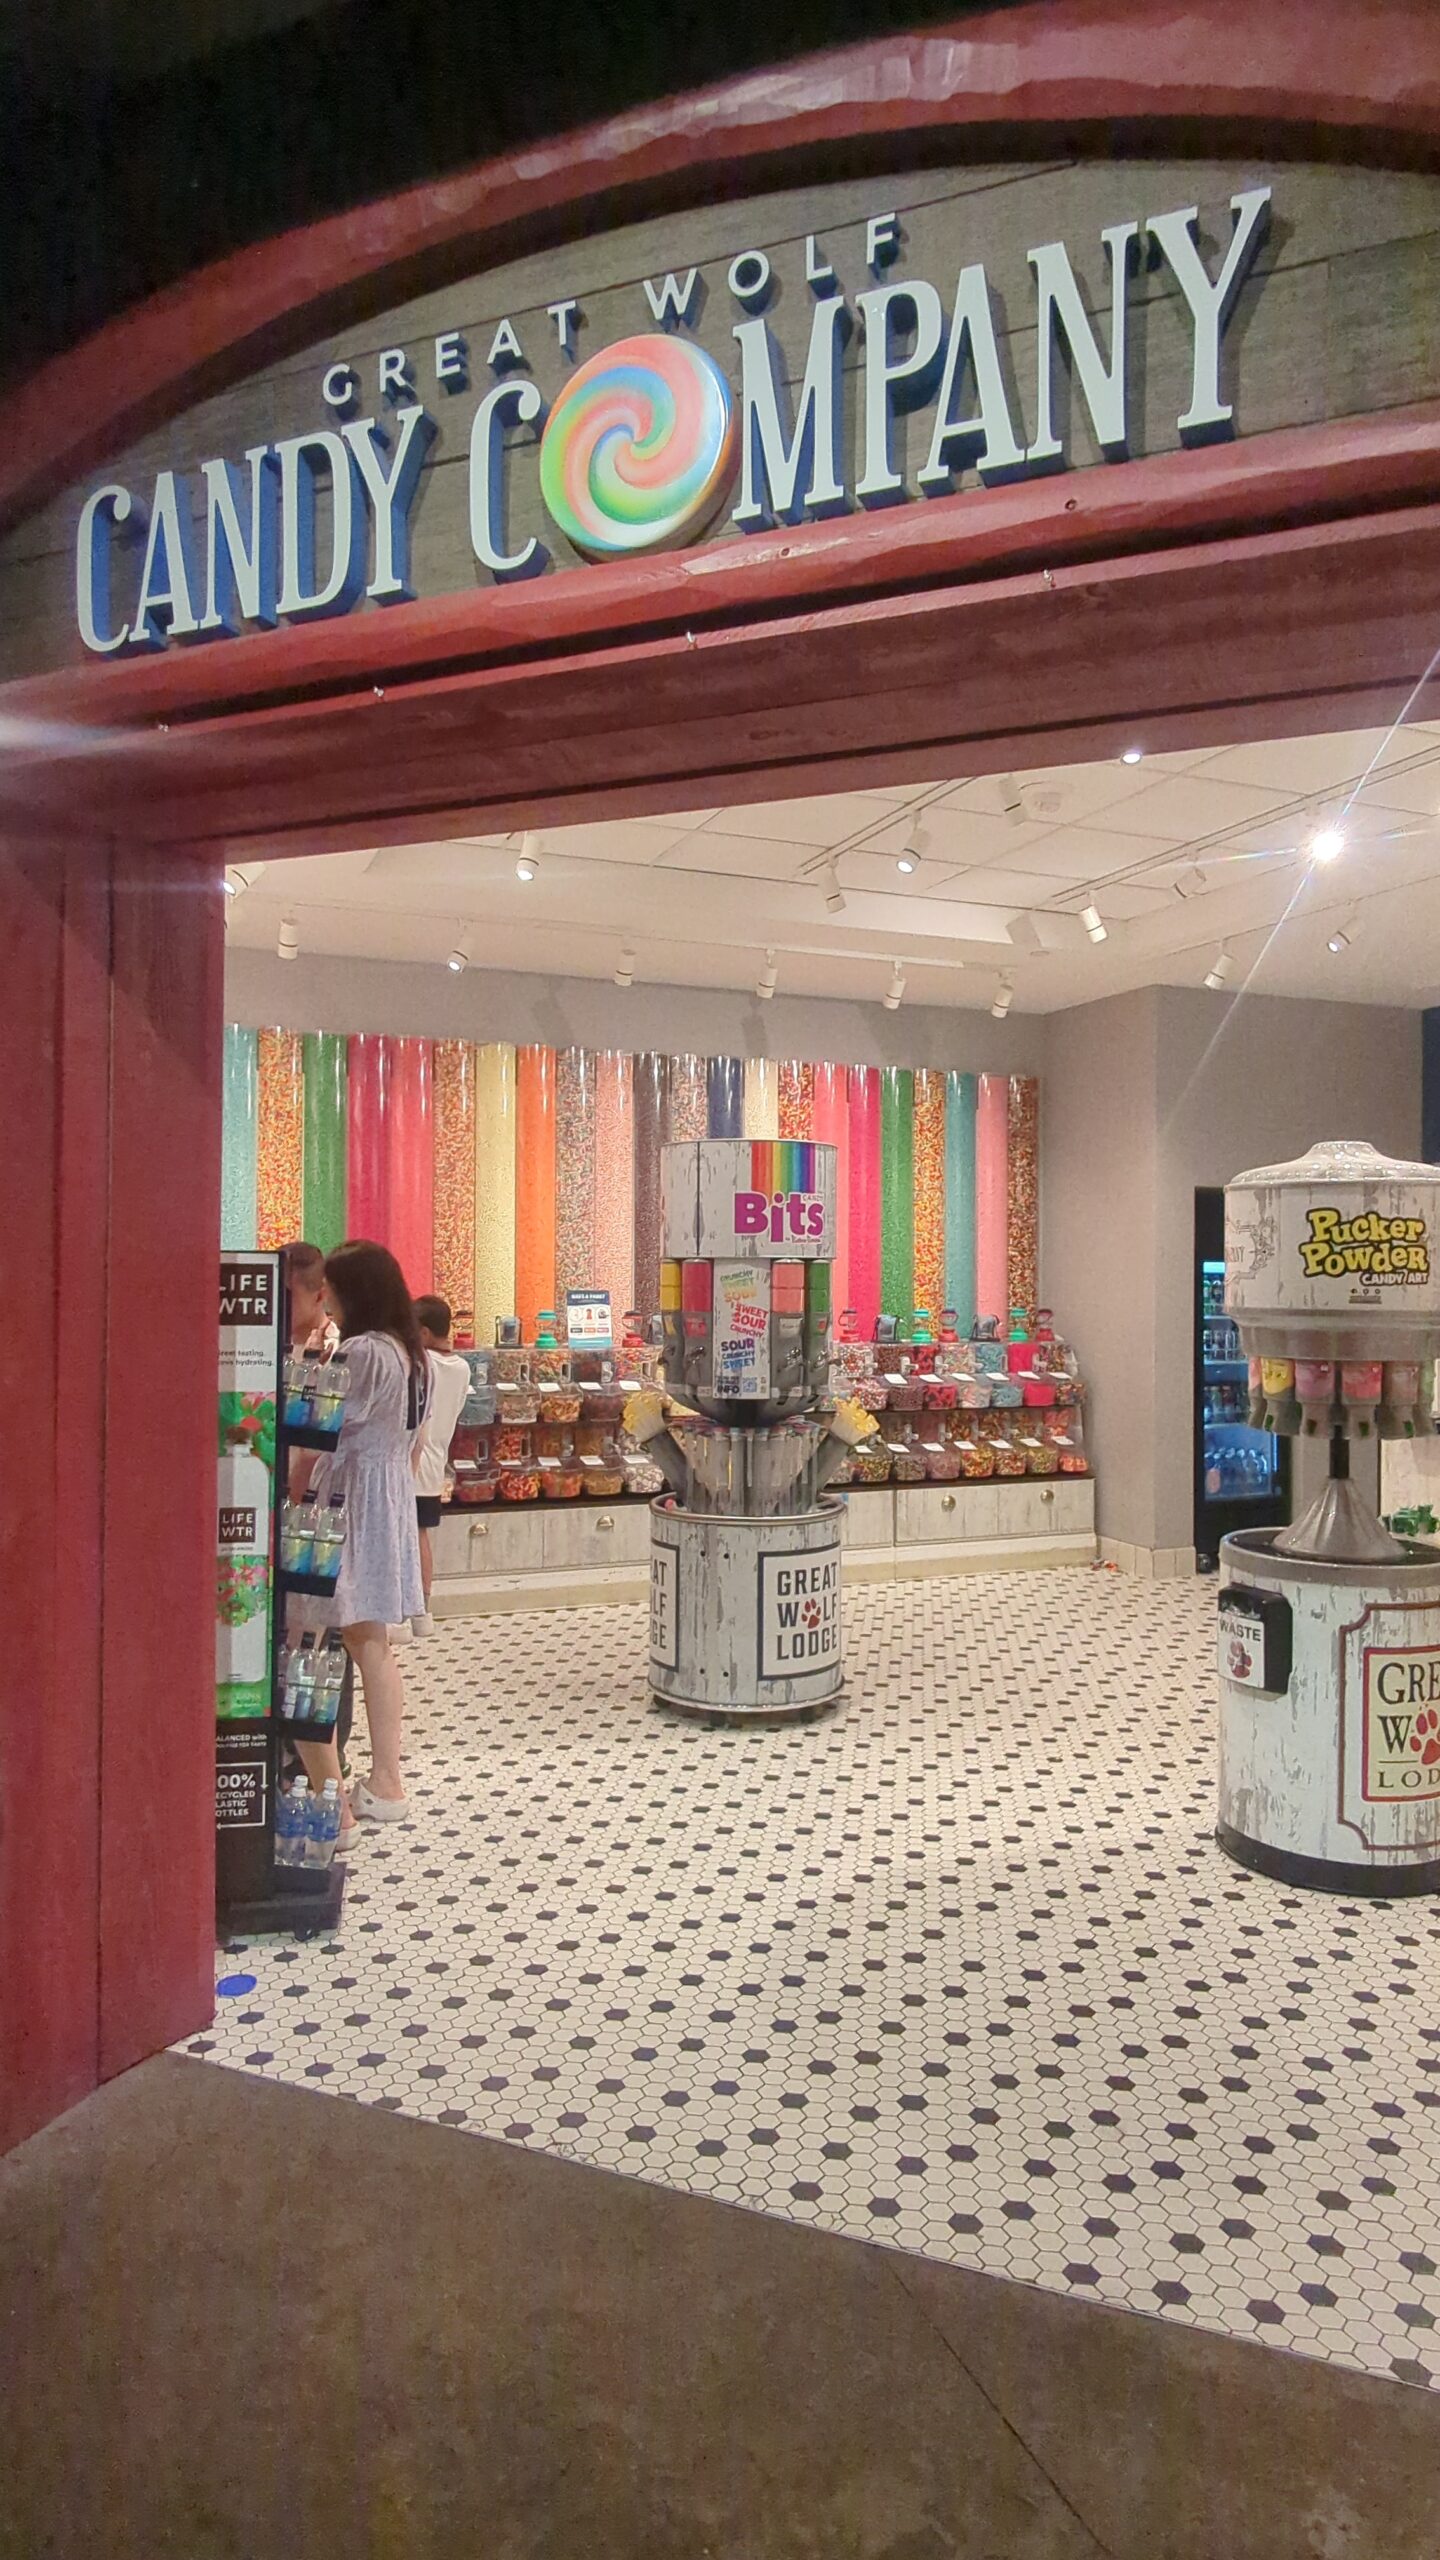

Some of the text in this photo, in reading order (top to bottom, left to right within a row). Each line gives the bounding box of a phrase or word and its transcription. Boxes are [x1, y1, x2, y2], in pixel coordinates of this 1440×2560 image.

[323, 212, 896, 406] GREAT WOLF
[76, 405, 423, 653] CANDY
[734, 1192, 824, 1242] Bits
[1306, 1207, 1426, 1245] Pucker
[1360, 1271, 1430, 1286] CANDY ART
[735, 1302, 769, 1319] SWEET
[732, 1312, 767, 1331] SOUR
[721, 1338, 755, 1352] SOUR
[723, 1357, 755, 1369] SWEET
[717, 1384, 740, 1394] INFO
[222, 1513, 254, 1524] LIFE
[221, 1526, 254, 1537] WTR
[776, 1561, 838, 1597] GREAT
[1220, 1619, 1262, 1642] WASTE
[776, 1623, 838, 1661] LODGE
